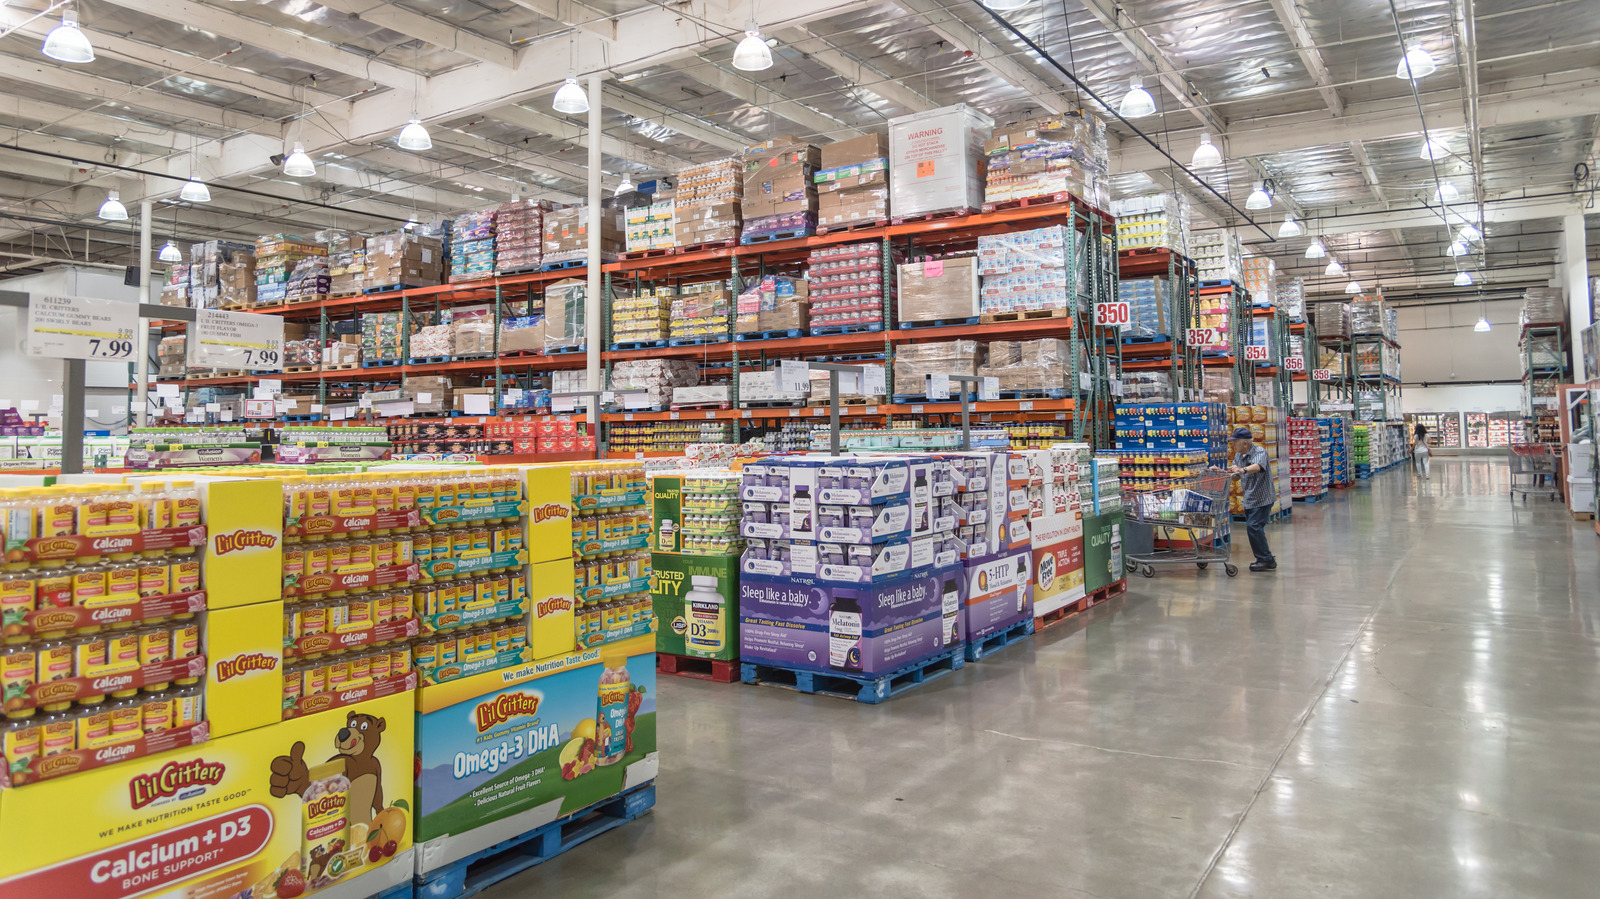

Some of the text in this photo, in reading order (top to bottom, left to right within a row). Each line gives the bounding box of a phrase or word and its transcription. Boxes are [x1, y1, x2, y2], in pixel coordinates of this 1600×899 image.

[908, 128, 943, 140] WARNING
[1097, 304, 1128, 324] 350
[1189, 329, 1212, 345] 352
[89, 339, 132, 357] 7.99
[1247, 346, 1267, 359] 354
[244, 350, 278, 365] 7.99
[1285, 358, 1303, 369] 356
[1313, 370, 1330, 380] 358
[795, 383, 809, 391] 11.99
[534, 504, 569, 523] L'il Critters
[343, 517, 370, 528] Calcium
[216, 530, 276, 554] L'il Critters
[1091, 531, 1110, 547] QUALITY
[1057, 550, 1067, 559] TRIPLE
[1058, 558, 1070, 567] ACTION
[1040, 556, 1053, 571] Move
[342, 574, 369, 585] Calcium
[654, 570, 685, 580] TRUSTED
[989, 564, 1009, 581] 5-HTP
[1041, 567, 1053, 583] Free
[742, 585, 812, 606] Sleep like a baby.
[878, 592, 894, 608] Sleep
[896, 589, 906, 602] like
[907, 589, 911, 600] a
[486, 607, 497, 615] DHA
[538, 597, 572, 618] L'il Critters
[691, 623, 706, 637] D3
[832, 618, 860, 627] Melatonin
[340, 633, 367, 644] Calcium
[218, 654, 278, 682] L'il Critters
[486, 658, 498, 666] DHA
[503, 672, 514, 682] We
[516, 668, 534, 678] make
[536, 659, 564, 672] Nutrition
[565, 655, 581, 667] Taste
[340, 689, 367, 701] Calcium
[477, 692, 540, 733] L'il Critters
[96, 744, 135, 760] Calcium
[454, 723, 560, 779] Omega-3 DHA
[131, 759, 224, 808] L'il Critters
[472, 786, 494, 798] Excellent
[494, 782, 509, 791] Source
[515, 771, 534, 783] Omega-3
[477, 778, 541, 806] Delicious Natural Fruit Flavors
[308, 795, 346, 819] L'il Critters
[117, 821, 143, 833] MAKE
[146, 806, 193, 824] NUTRITION
[196, 798, 220, 809] TASTE
[309, 824, 334, 836] Calcium
[90, 815, 251, 884] Calcium + D3
[122, 869, 159, 889] BONE
